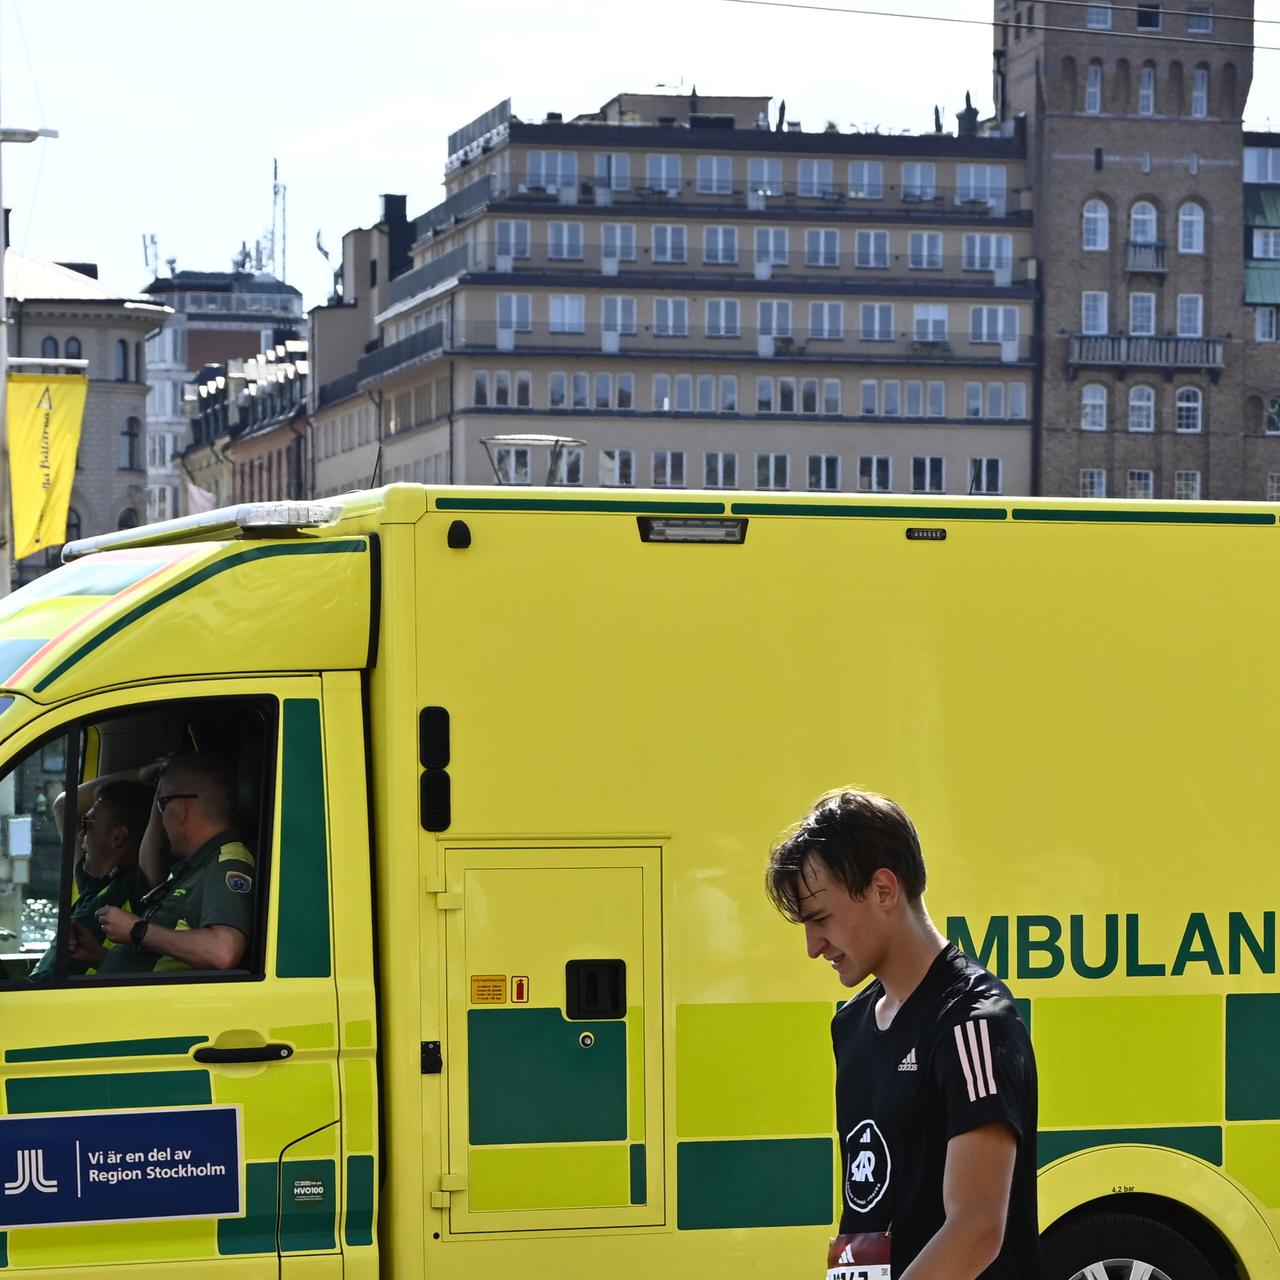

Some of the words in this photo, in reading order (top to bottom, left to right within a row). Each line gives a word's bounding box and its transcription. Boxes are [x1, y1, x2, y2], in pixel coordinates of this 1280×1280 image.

[897, 1063, 918, 1072] adidas
[88, 1151, 104, 1165] Vi
[107, 1150, 122, 1164] är
[125, 1152, 145, 1163] en
[148, 1148, 171, 1162] del
[174, 1150, 192, 1160] av
[89, 1167, 142, 1184] Region
[146, 1162, 226, 1180] Stockholm
[294, 1186, 324, 1195] HVO100
